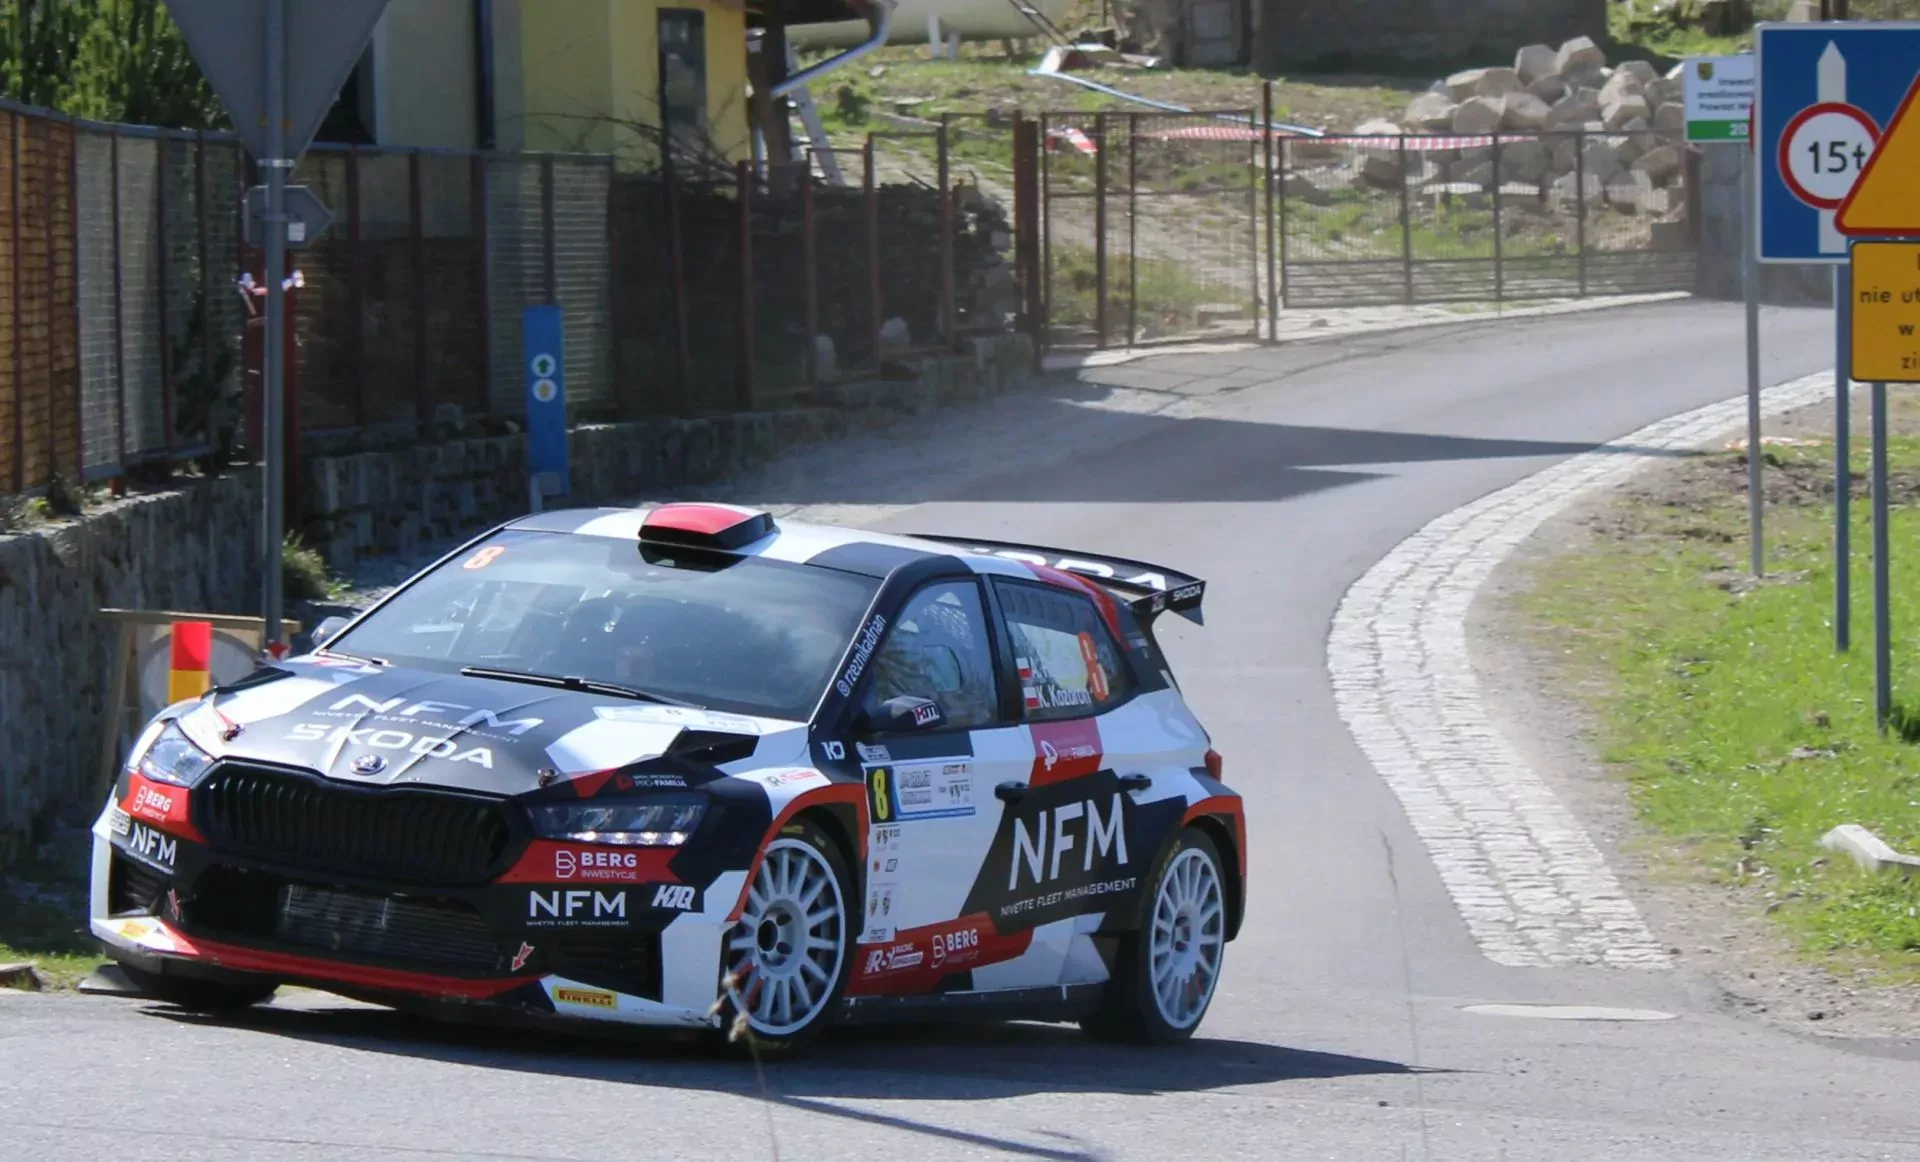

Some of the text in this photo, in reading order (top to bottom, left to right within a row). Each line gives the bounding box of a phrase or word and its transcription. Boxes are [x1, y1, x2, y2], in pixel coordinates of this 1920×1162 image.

[1808, 140, 1866, 174] 15t
[1859, 285, 1892, 303] nie
[1898, 324, 1915, 336] w
[1902, 351, 1920, 370] zi
[463, 546, 506, 570] 8
[329, 693, 544, 735] NFM
[282, 723, 494, 769] SKODA
[146, 790, 172, 812] BERG
[872, 768, 890, 820] 8
[130, 822, 177, 867] NFM
[1008, 792, 1129, 892] NFM
[580, 851, 637, 868] BERG
[529, 890, 626, 917] NFM
[1000, 877, 1137, 917] NIVETTE FLEET MANAGEMENT
[947, 928, 979, 951] BERG
